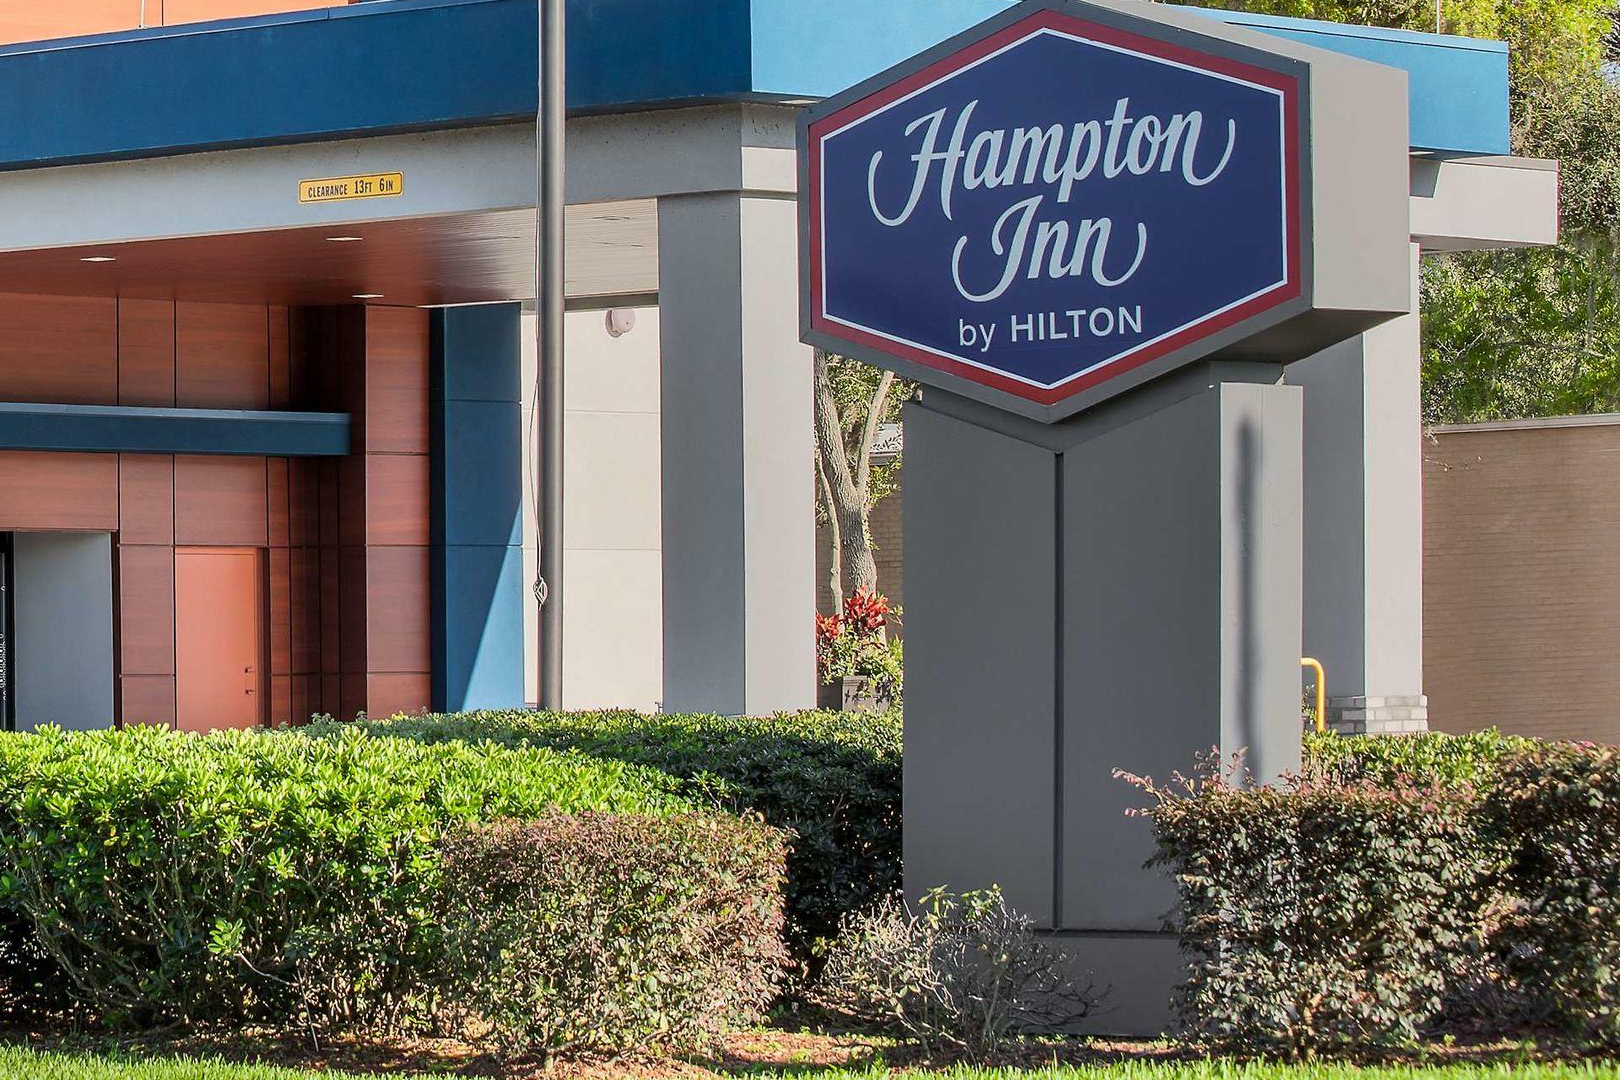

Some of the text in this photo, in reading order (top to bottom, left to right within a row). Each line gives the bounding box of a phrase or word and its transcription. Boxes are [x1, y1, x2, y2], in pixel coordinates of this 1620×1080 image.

[307, 183, 348, 199] CLEARANCE
[867, 97, 1237, 227] Hampton
[951, 194, 1147, 303] Inn
[958, 305, 1143, 353] by HILTON
